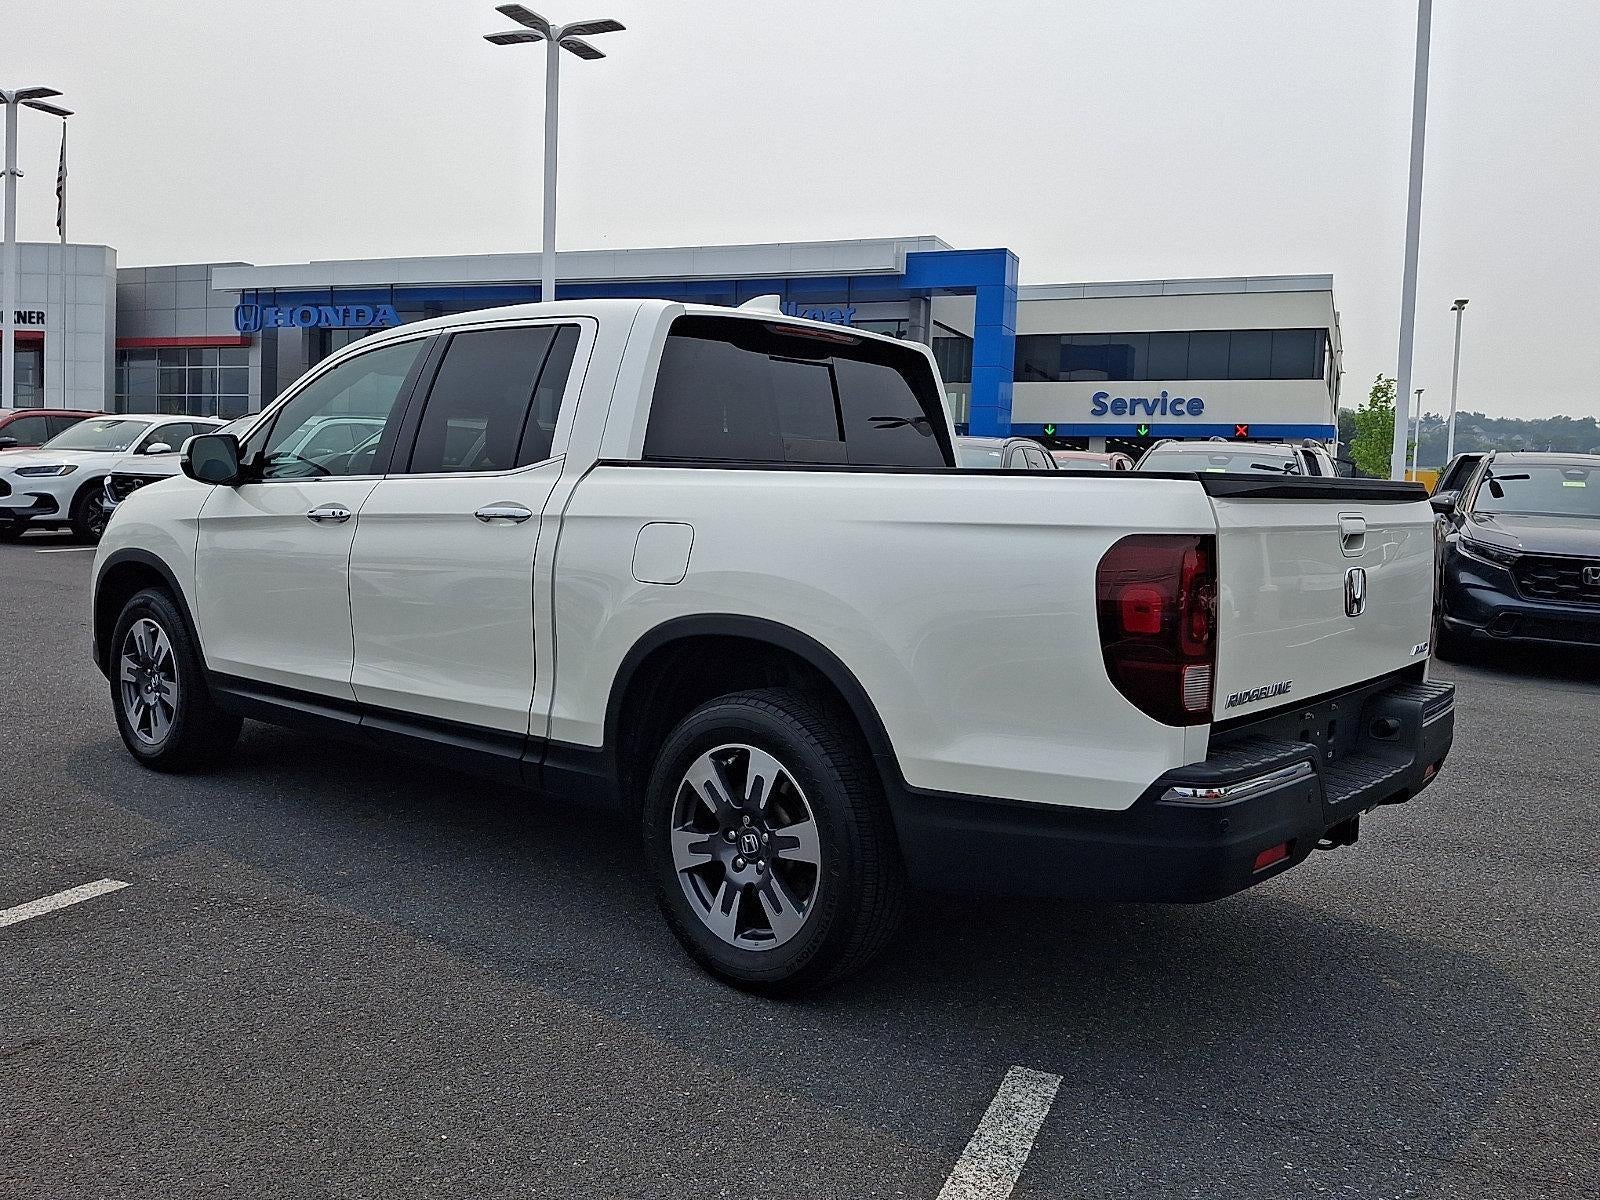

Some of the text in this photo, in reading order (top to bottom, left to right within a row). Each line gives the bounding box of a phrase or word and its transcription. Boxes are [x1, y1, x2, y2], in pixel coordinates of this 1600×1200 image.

[264, 304, 401, 328] HONDA
[1090, 390, 1205, 417] Service
[1224, 679, 1293, 709] RIDGELINE
